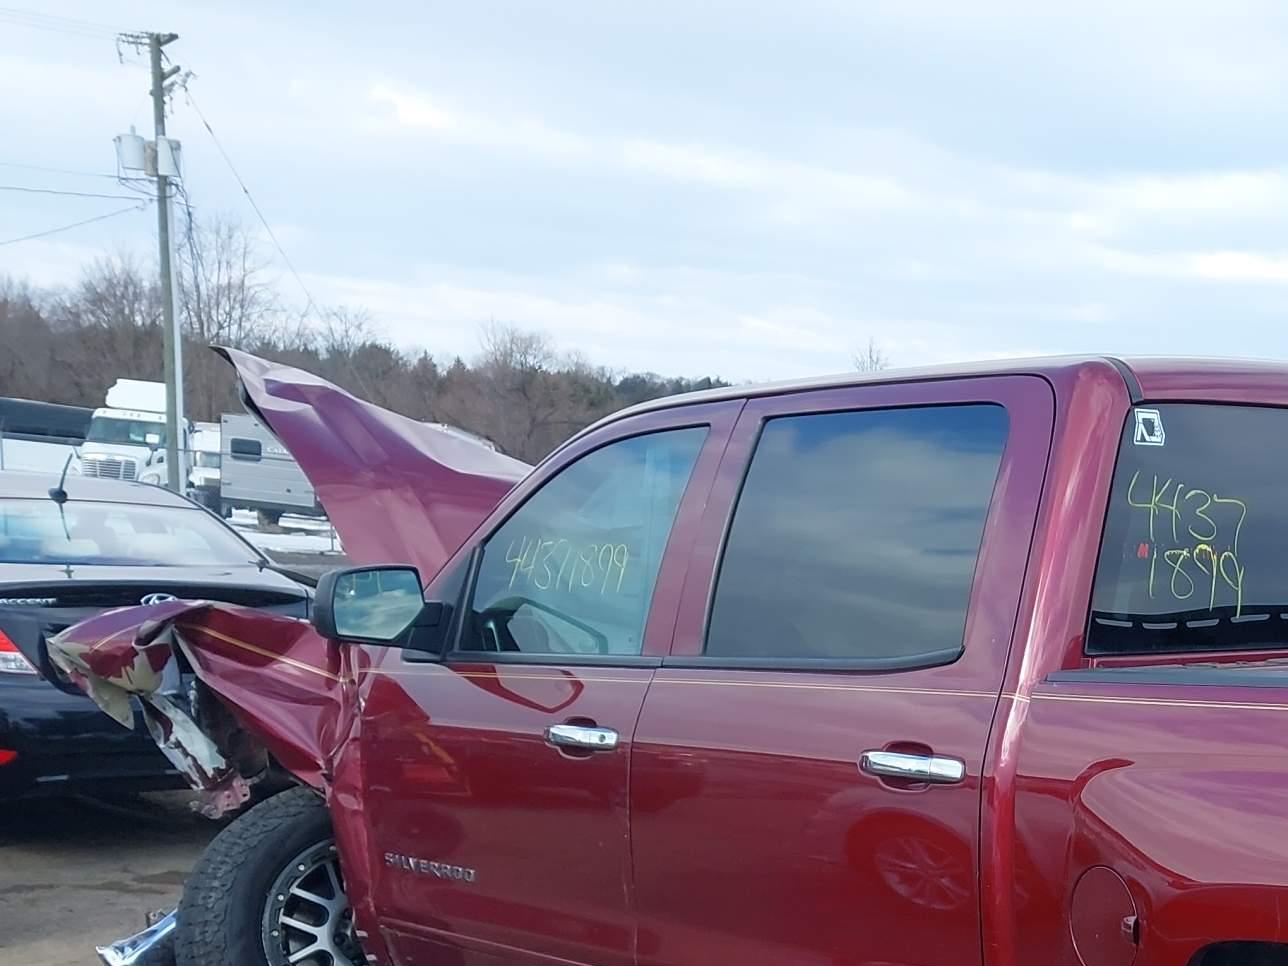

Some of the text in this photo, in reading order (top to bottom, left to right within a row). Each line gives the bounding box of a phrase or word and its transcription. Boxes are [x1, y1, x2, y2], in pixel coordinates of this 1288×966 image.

[1128, 470, 1247, 556] 4437
[505, 536, 628, 594] 44371899
[1149, 543, 1245, 619] 1899
[383, 851, 475, 882] SILVERADO
